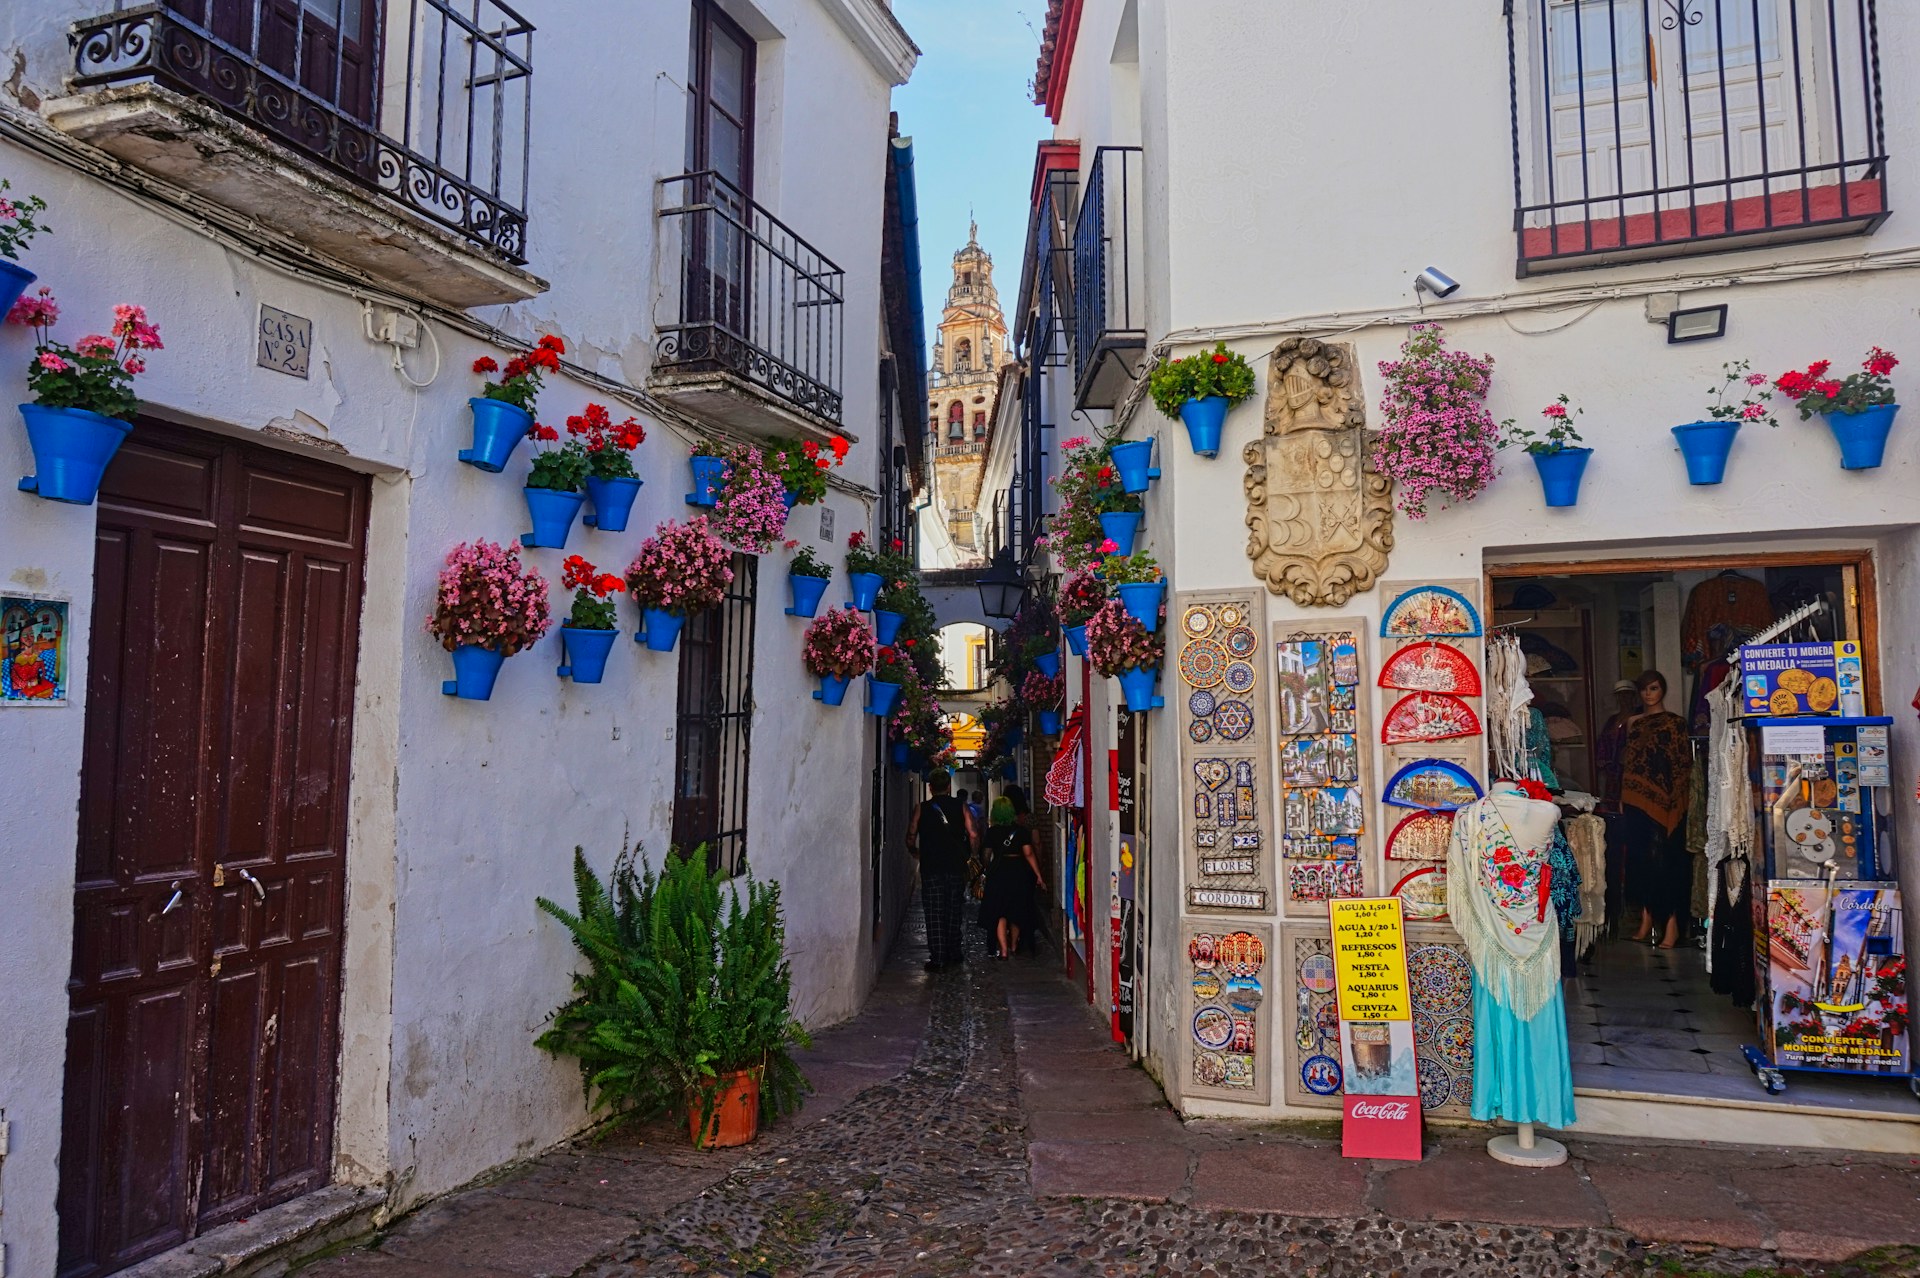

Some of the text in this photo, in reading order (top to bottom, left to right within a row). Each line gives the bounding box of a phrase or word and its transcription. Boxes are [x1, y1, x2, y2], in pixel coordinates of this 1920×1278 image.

[263, 318, 306, 348] CASA
[1744, 646, 1834, 658] CONVIERTE TU MONEDA
[1746, 662, 1756, 671] EN
[1757, 659, 1796, 670] MEDALLA
[1199, 834, 1213, 843] WC
[1205, 861, 1252, 872] FLORES
[1199, 892, 1254, 905] CORDOBA
[1840, 897, 1890, 910] Córdoba
[1347, 984, 1398, 992] AQUARIUS
[1801, 1035, 1881, 1046] CONVIERTE TU
[1783, 1044, 1829, 1053] MONEDA
[1850, 1047, 1901, 1057] MEDALLA
[1352, 1101, 1410, 1120] Coca-Cola
